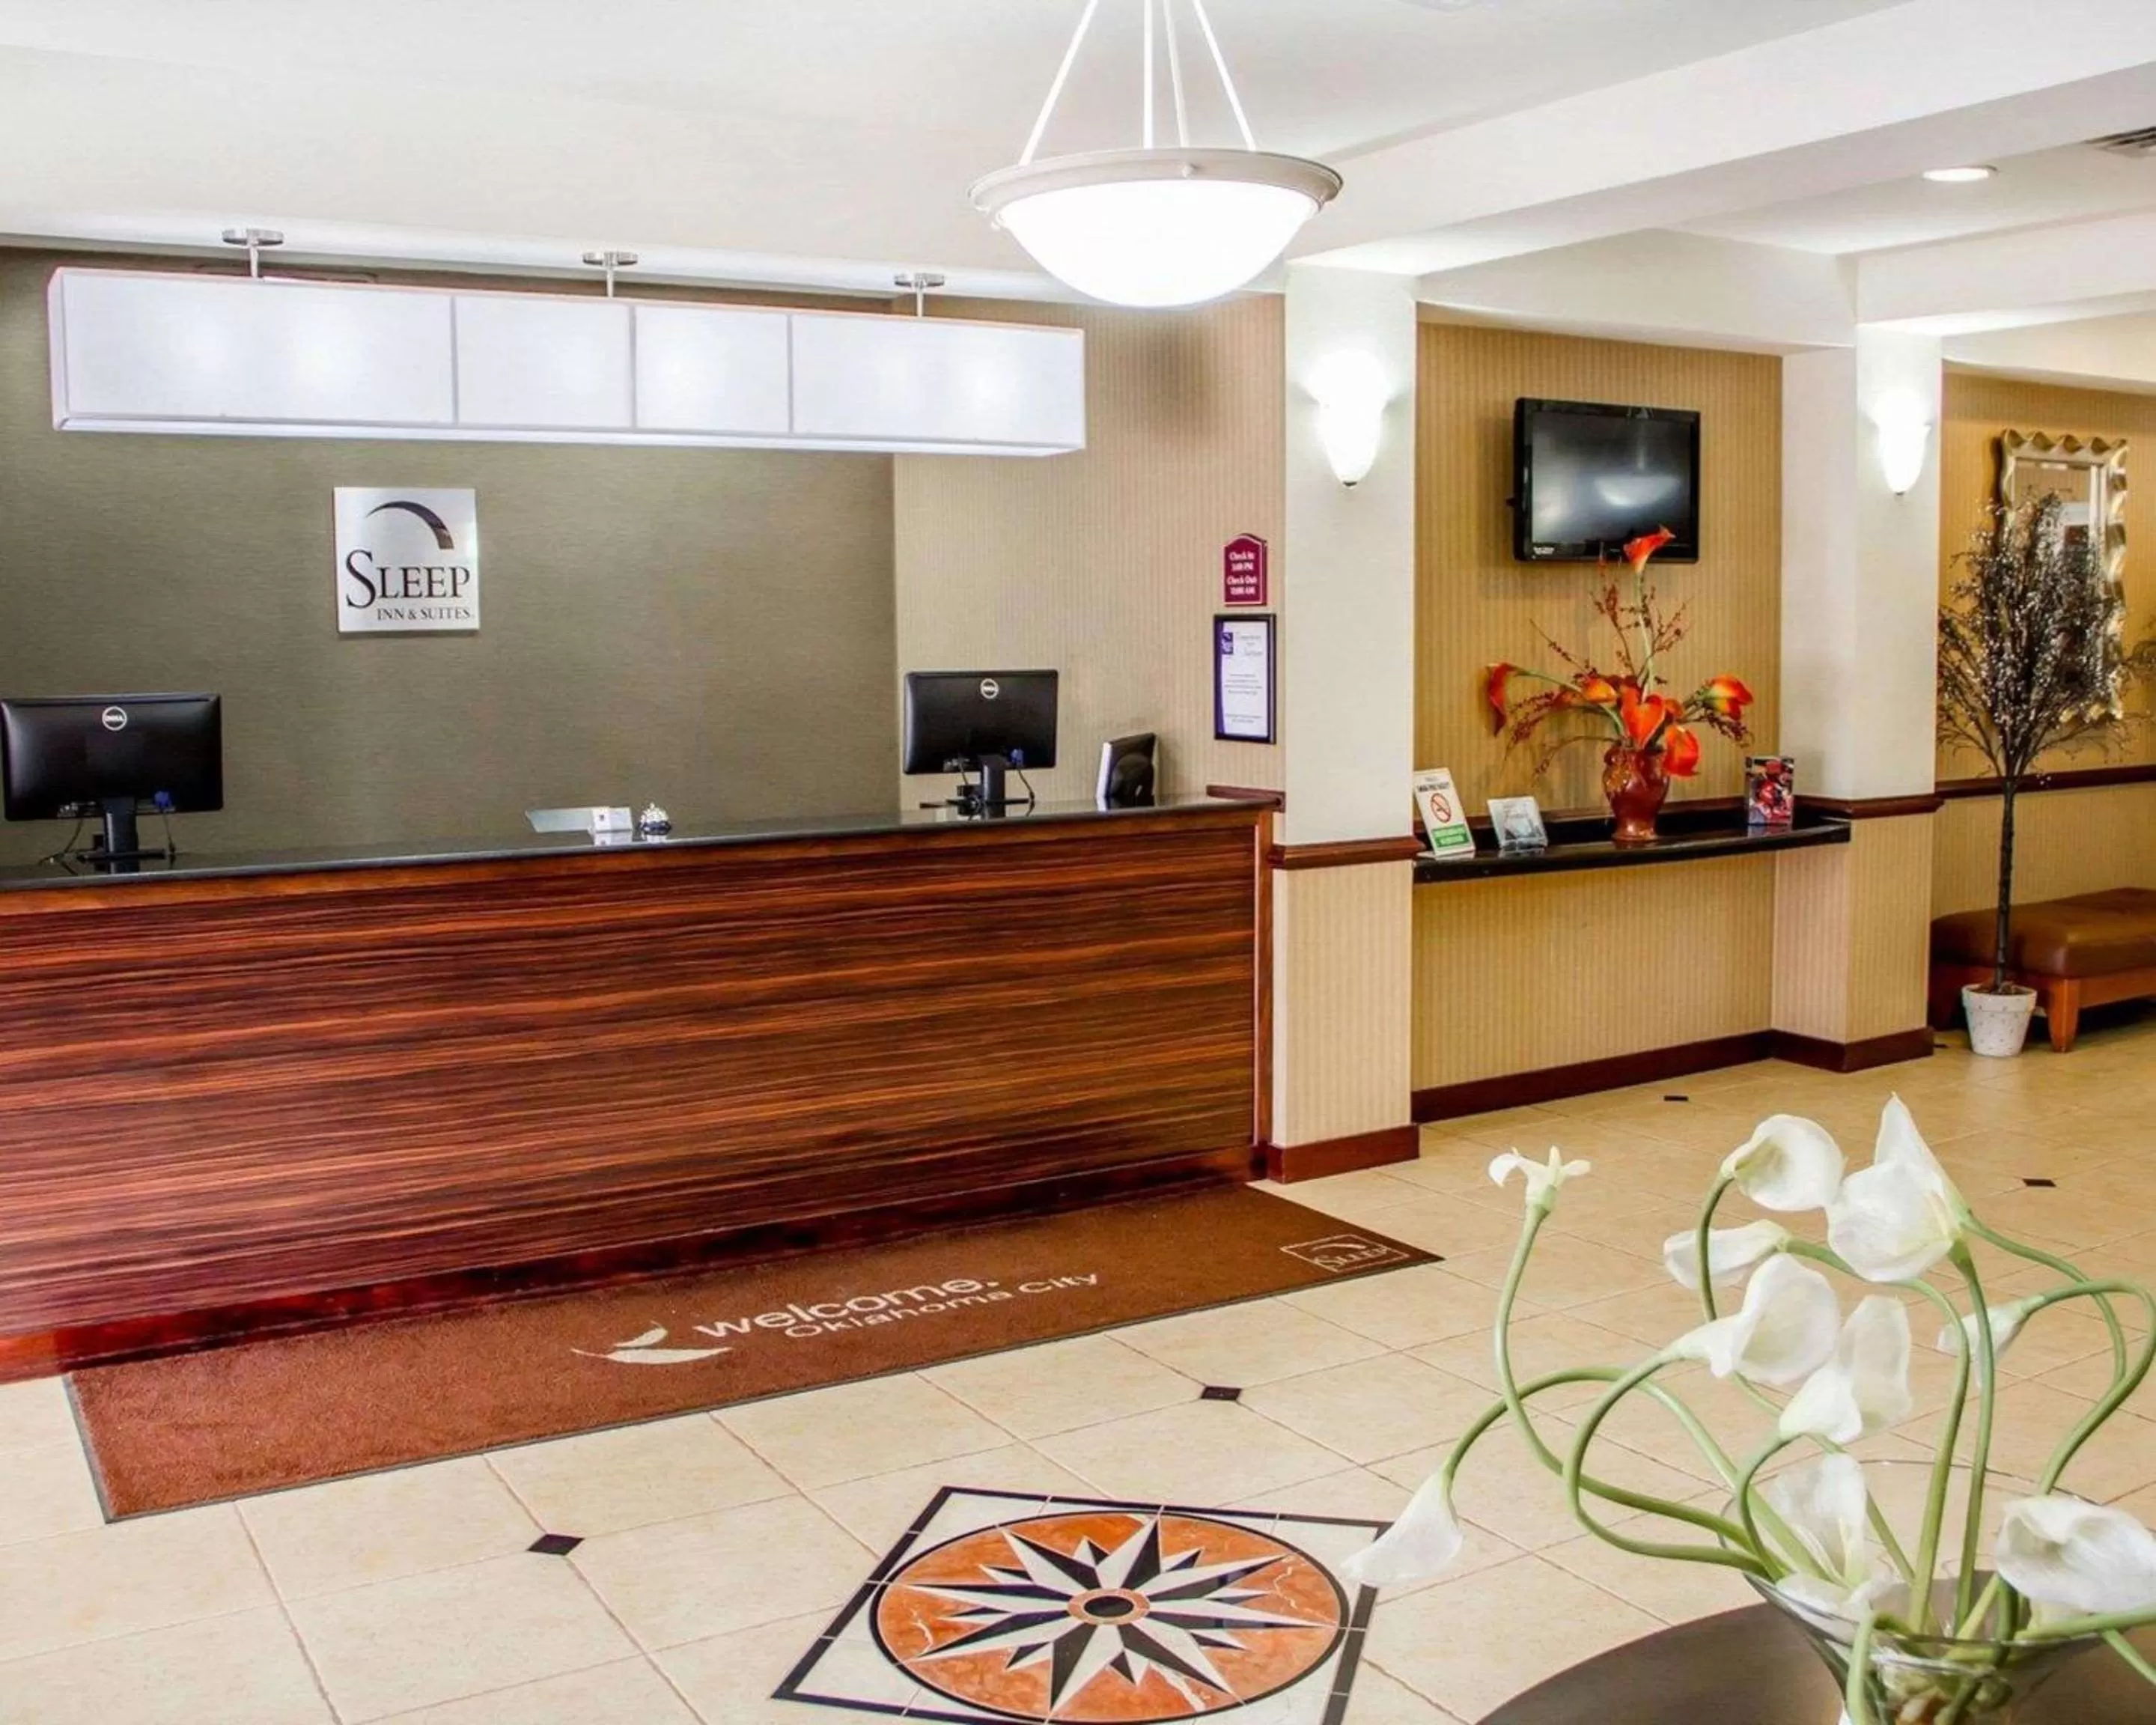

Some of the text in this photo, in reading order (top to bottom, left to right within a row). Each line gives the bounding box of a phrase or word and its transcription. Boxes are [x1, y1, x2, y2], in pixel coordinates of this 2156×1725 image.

[345, 550, 470, 609] SLEEP
[377, 606, 471, 621] INN & SUITES
[692, 1279, 999, 1338] welcome.
[785, 1273, 1097, 1338] Oklahoma City
